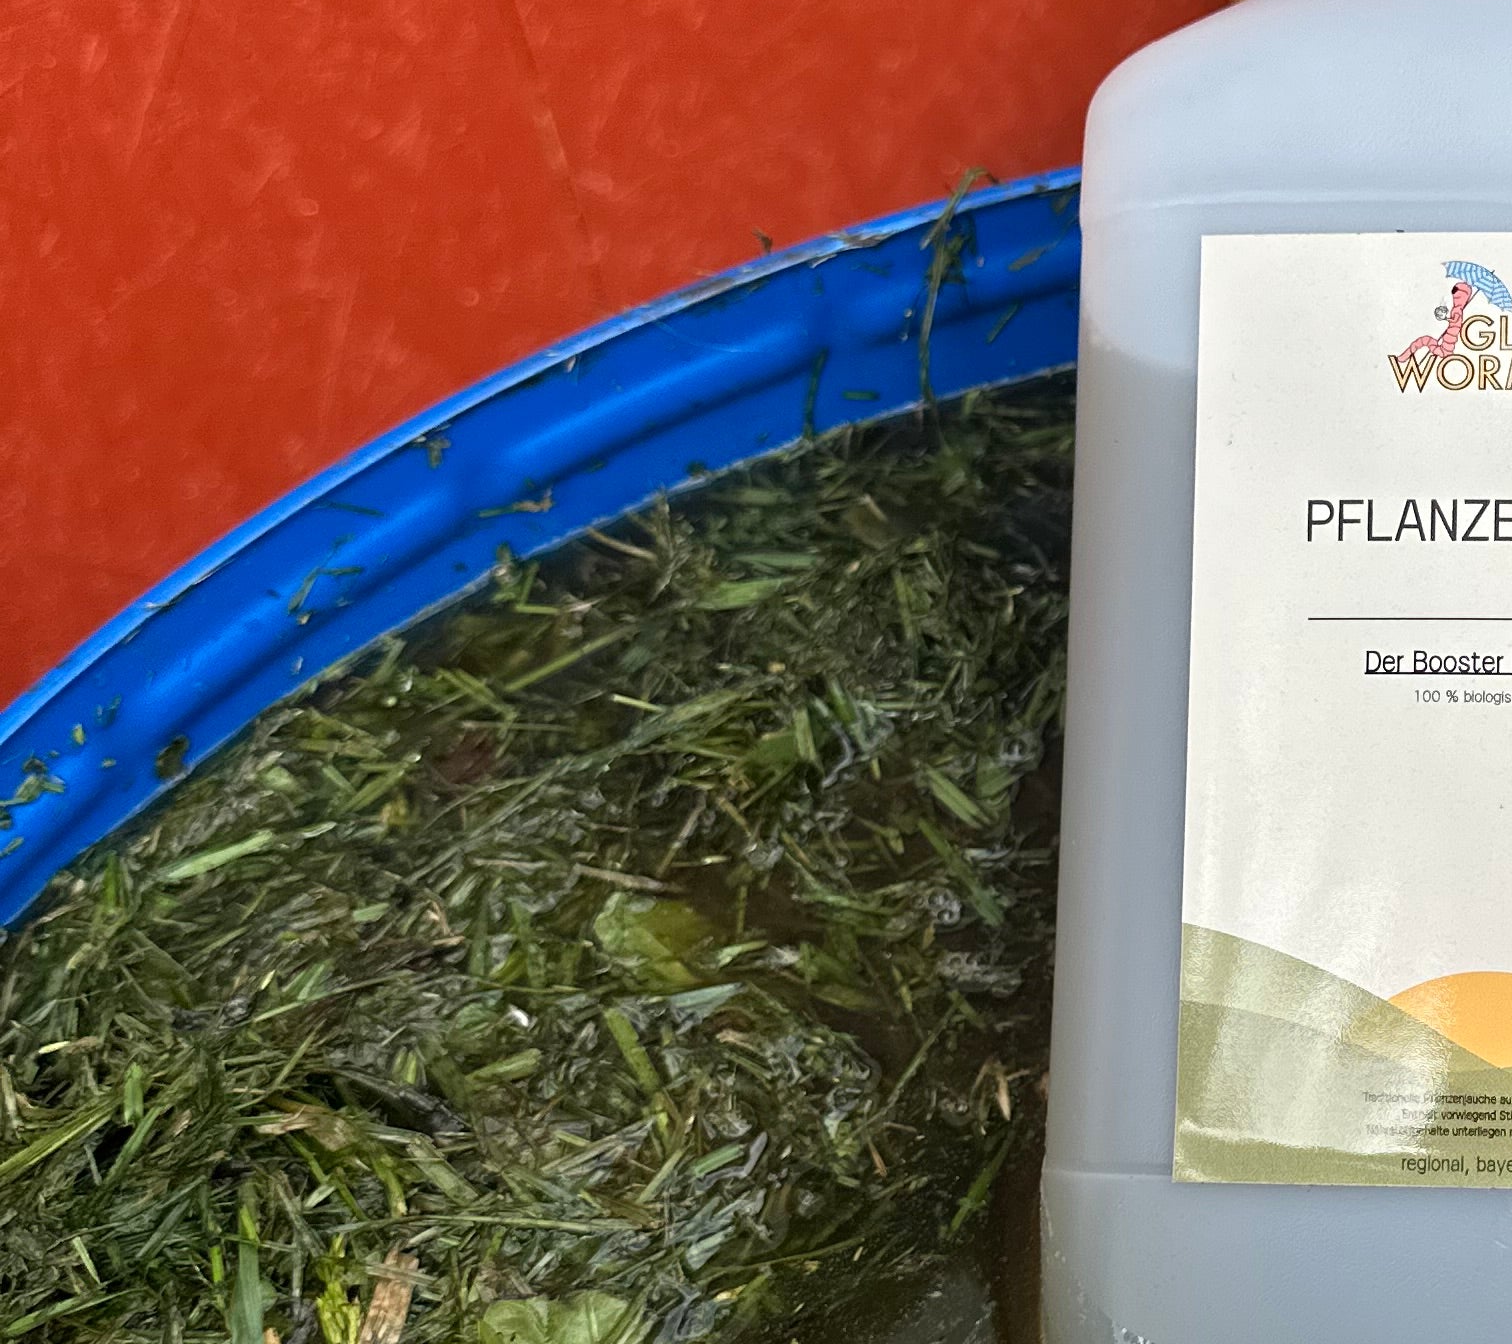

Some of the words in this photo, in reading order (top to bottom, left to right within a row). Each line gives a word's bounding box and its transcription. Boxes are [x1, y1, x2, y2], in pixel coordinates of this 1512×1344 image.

[1364, 650, 1405, 674] Der
[1413, 650, 1504, 675] Booster
[1413, 689, 1441, 704] 100
[1445, 690, 1459, 704] %
[1441, 1109, 1497, 1123] vorwiegend
[1452, 1126, 1507, 1139] unterliegen
[1401, 1155, 1470, 1176] regional,
